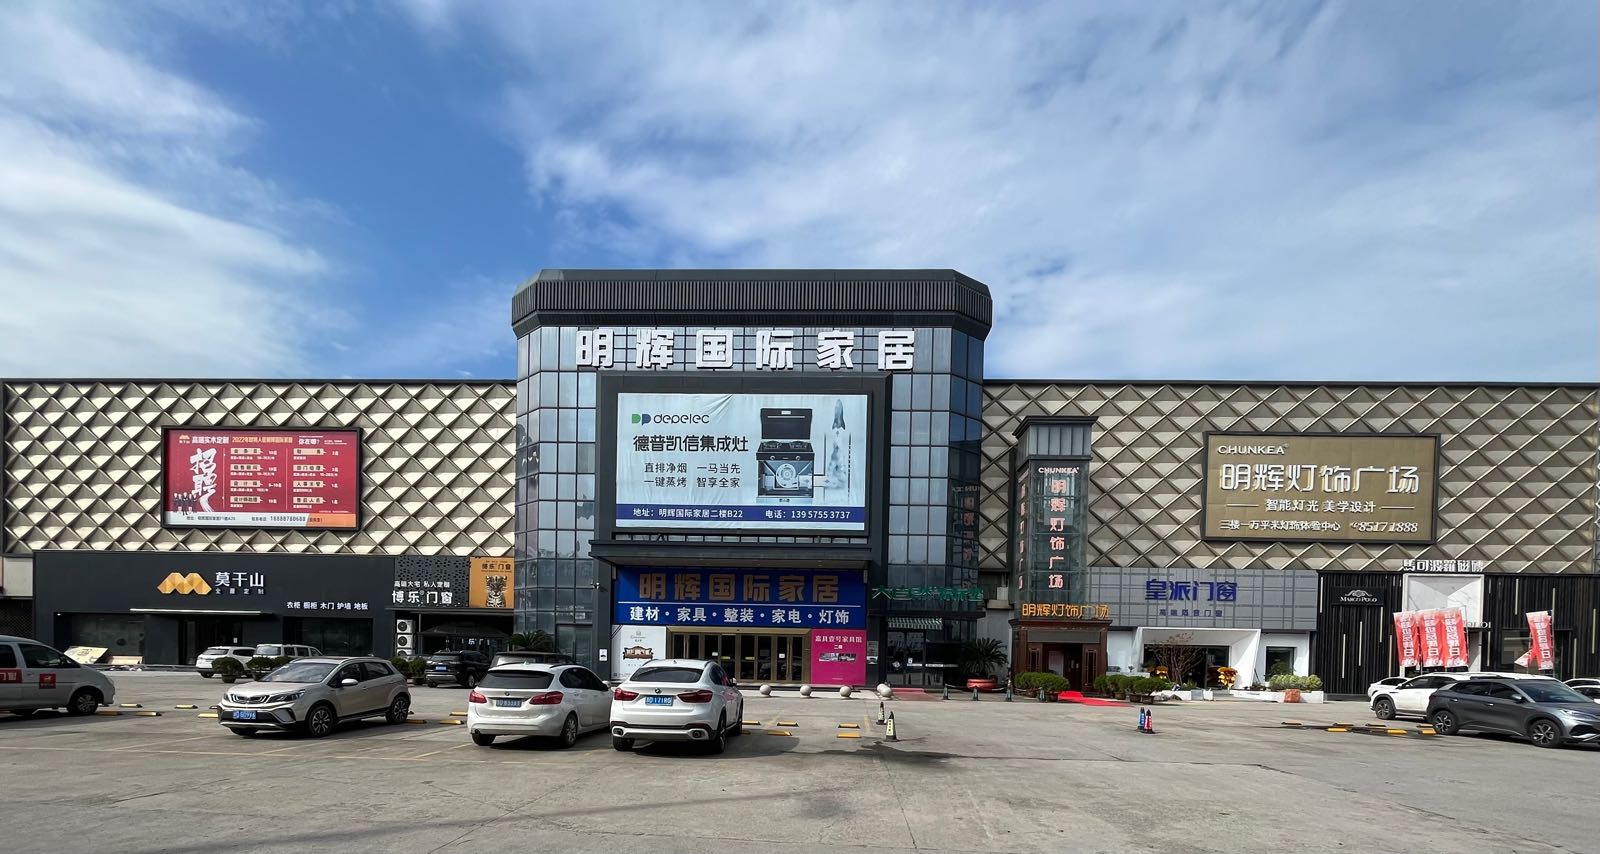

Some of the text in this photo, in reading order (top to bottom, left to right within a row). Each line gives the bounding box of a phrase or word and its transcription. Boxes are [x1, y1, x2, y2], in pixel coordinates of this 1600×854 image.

[576, 329, 915, 370] 明辉国际家居
[653, 413, 710, 425] depelec
[633, 435, 749, 453] 德普凯信集成灶
[1218, 445, 1285, 455] CHUNKEA
[644, 463, 740, 474] 直排净烟 一马当先
[644, 477, 740, 488] 一键蒸烤 智享全家
[1220, 464, 1420, 494] 明辉灯饰广场
[1266, 499, 1376, 513] 智能灯光 美学设计
[1220, 519, 1341, 531] 三楼一万平米灯饰体验中心
[1049, 479, 1067, 589] 明辉灯饰广场
[215, 572, 264, 587] 莫干山
[639, 573, 839, 602] 明辉国际家居
[1145, 579, 1237, 601] 皇派门窗
[286, 601, 368, 611] 衣柜 橱柜 木门 护墙 地板
[1022, 603, 1110, 619] 明辉灯饰广场
